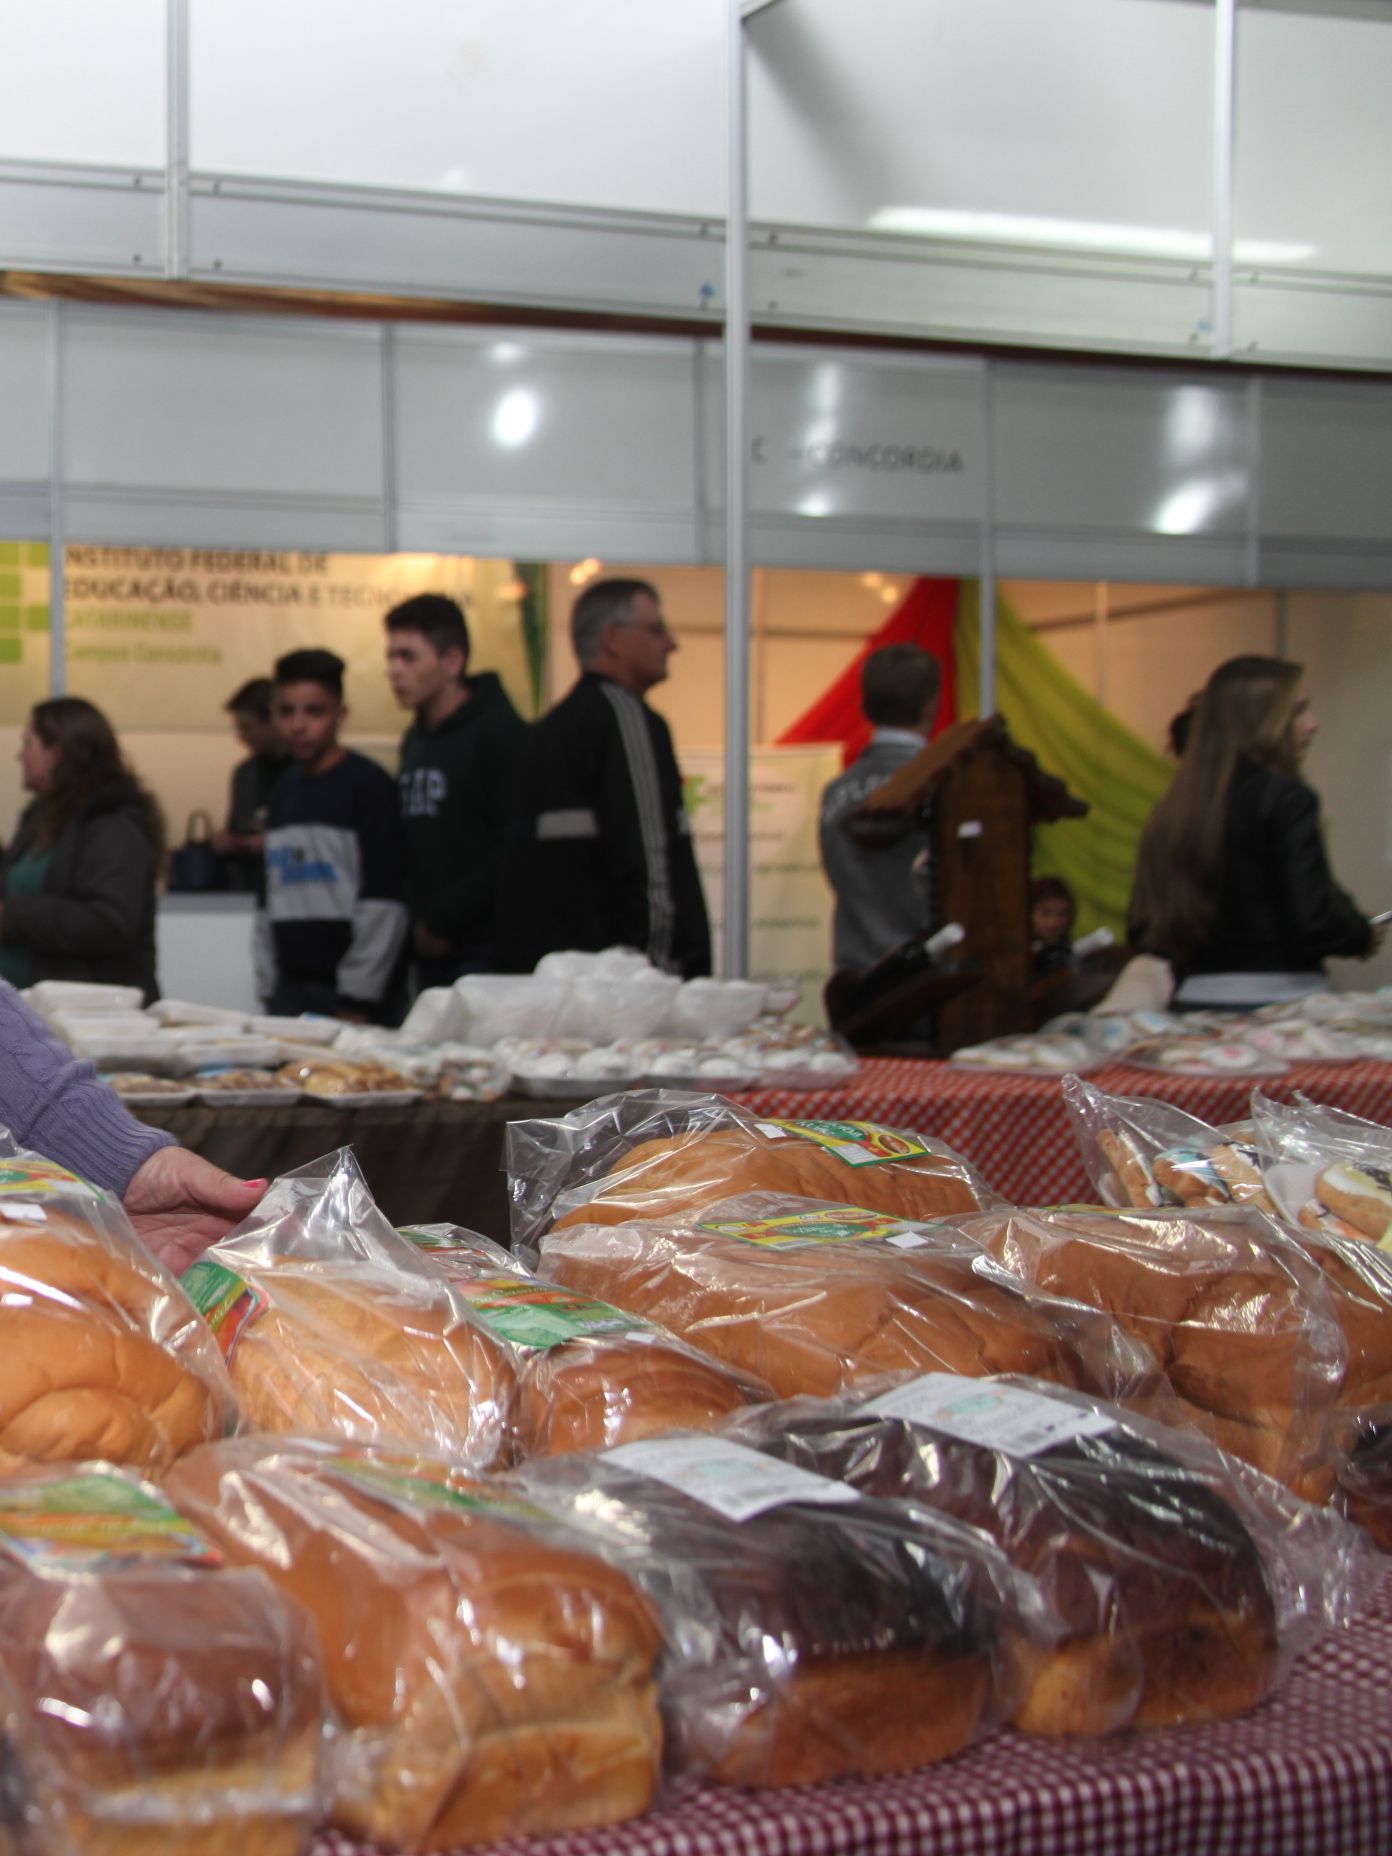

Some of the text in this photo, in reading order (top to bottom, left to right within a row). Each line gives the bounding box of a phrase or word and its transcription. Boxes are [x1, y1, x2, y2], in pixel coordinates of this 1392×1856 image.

[66, 548, 328, 575] NSTITUTO FEDERAL DE
[208, 577, 300, 606] CIÊNCIA
[309, 584, 321, 606] E
